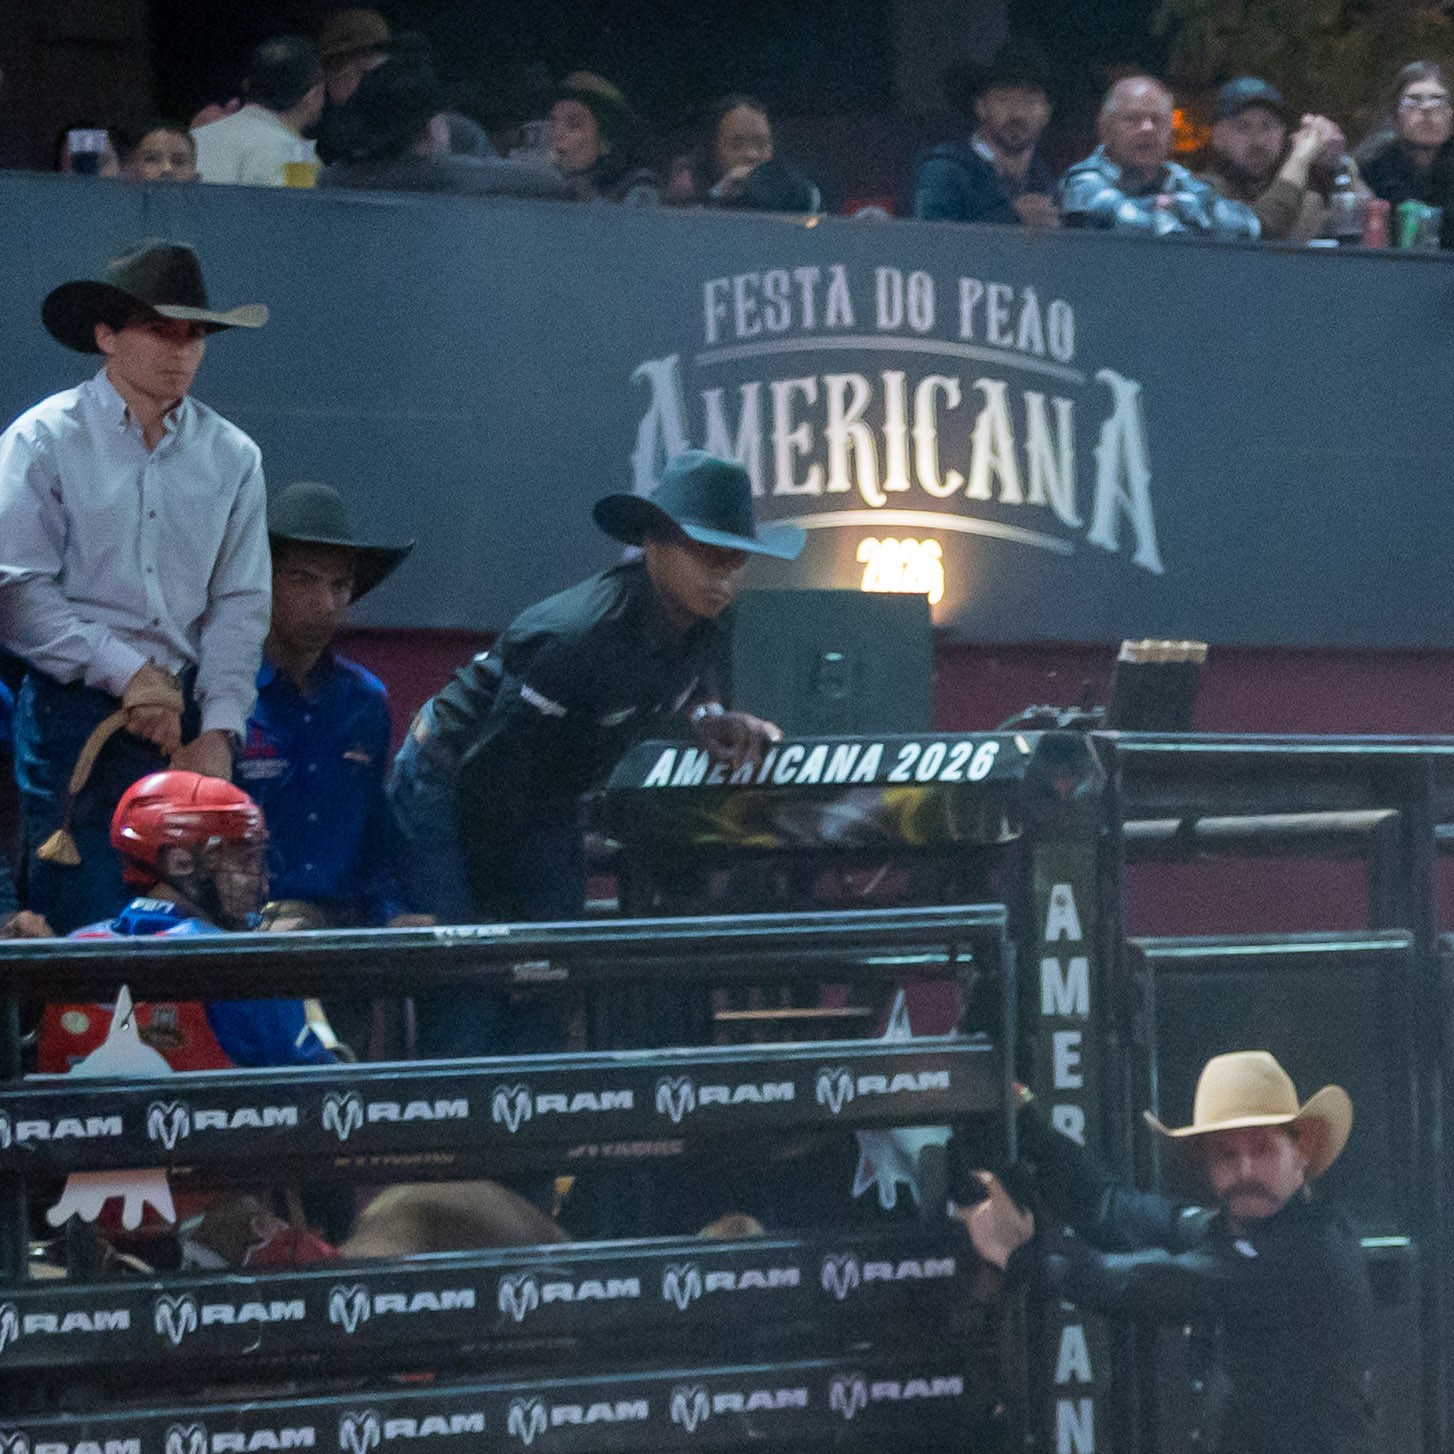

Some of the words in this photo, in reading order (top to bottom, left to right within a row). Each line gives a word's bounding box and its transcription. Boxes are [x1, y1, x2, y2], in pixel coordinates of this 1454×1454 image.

[703, 266, 855, 343] FESTA
[875, 267, 936, 332] DO
[630, 352, 1165, 576] AMERICANA
[643, 744, 884, 787] AMERICANA
[887, 741, 1000, 782] 2026
[17, 1114, 122, 1140] RAM
[194, 1107, 298, 1130] RAM
[368, 1100, 468, 1123] RAM
[537, 1090, 633, 1114] RAM
[700, 1081, 794, 1106] RAM
[857, 1071, 950, 1094] RAM
[24, 1310, 130, 1333] RAM
[202, 1301, 304, 1325] RAM
[375, 1290, 475, 1315] RAM
[542, 1278, 639, 1303] RAM
[705, 1268, 799, 1290] RAM
[864, 1258, 955, 1281] RAM
[212, 1428, 315, 1453] RAM
[385, 1414, 486, 1439] RAM
[552, 1401, 649, 1425] RAM
[714, 1388, 808, 1412] RAM
[871, 1378, 963, 1401] RAM
